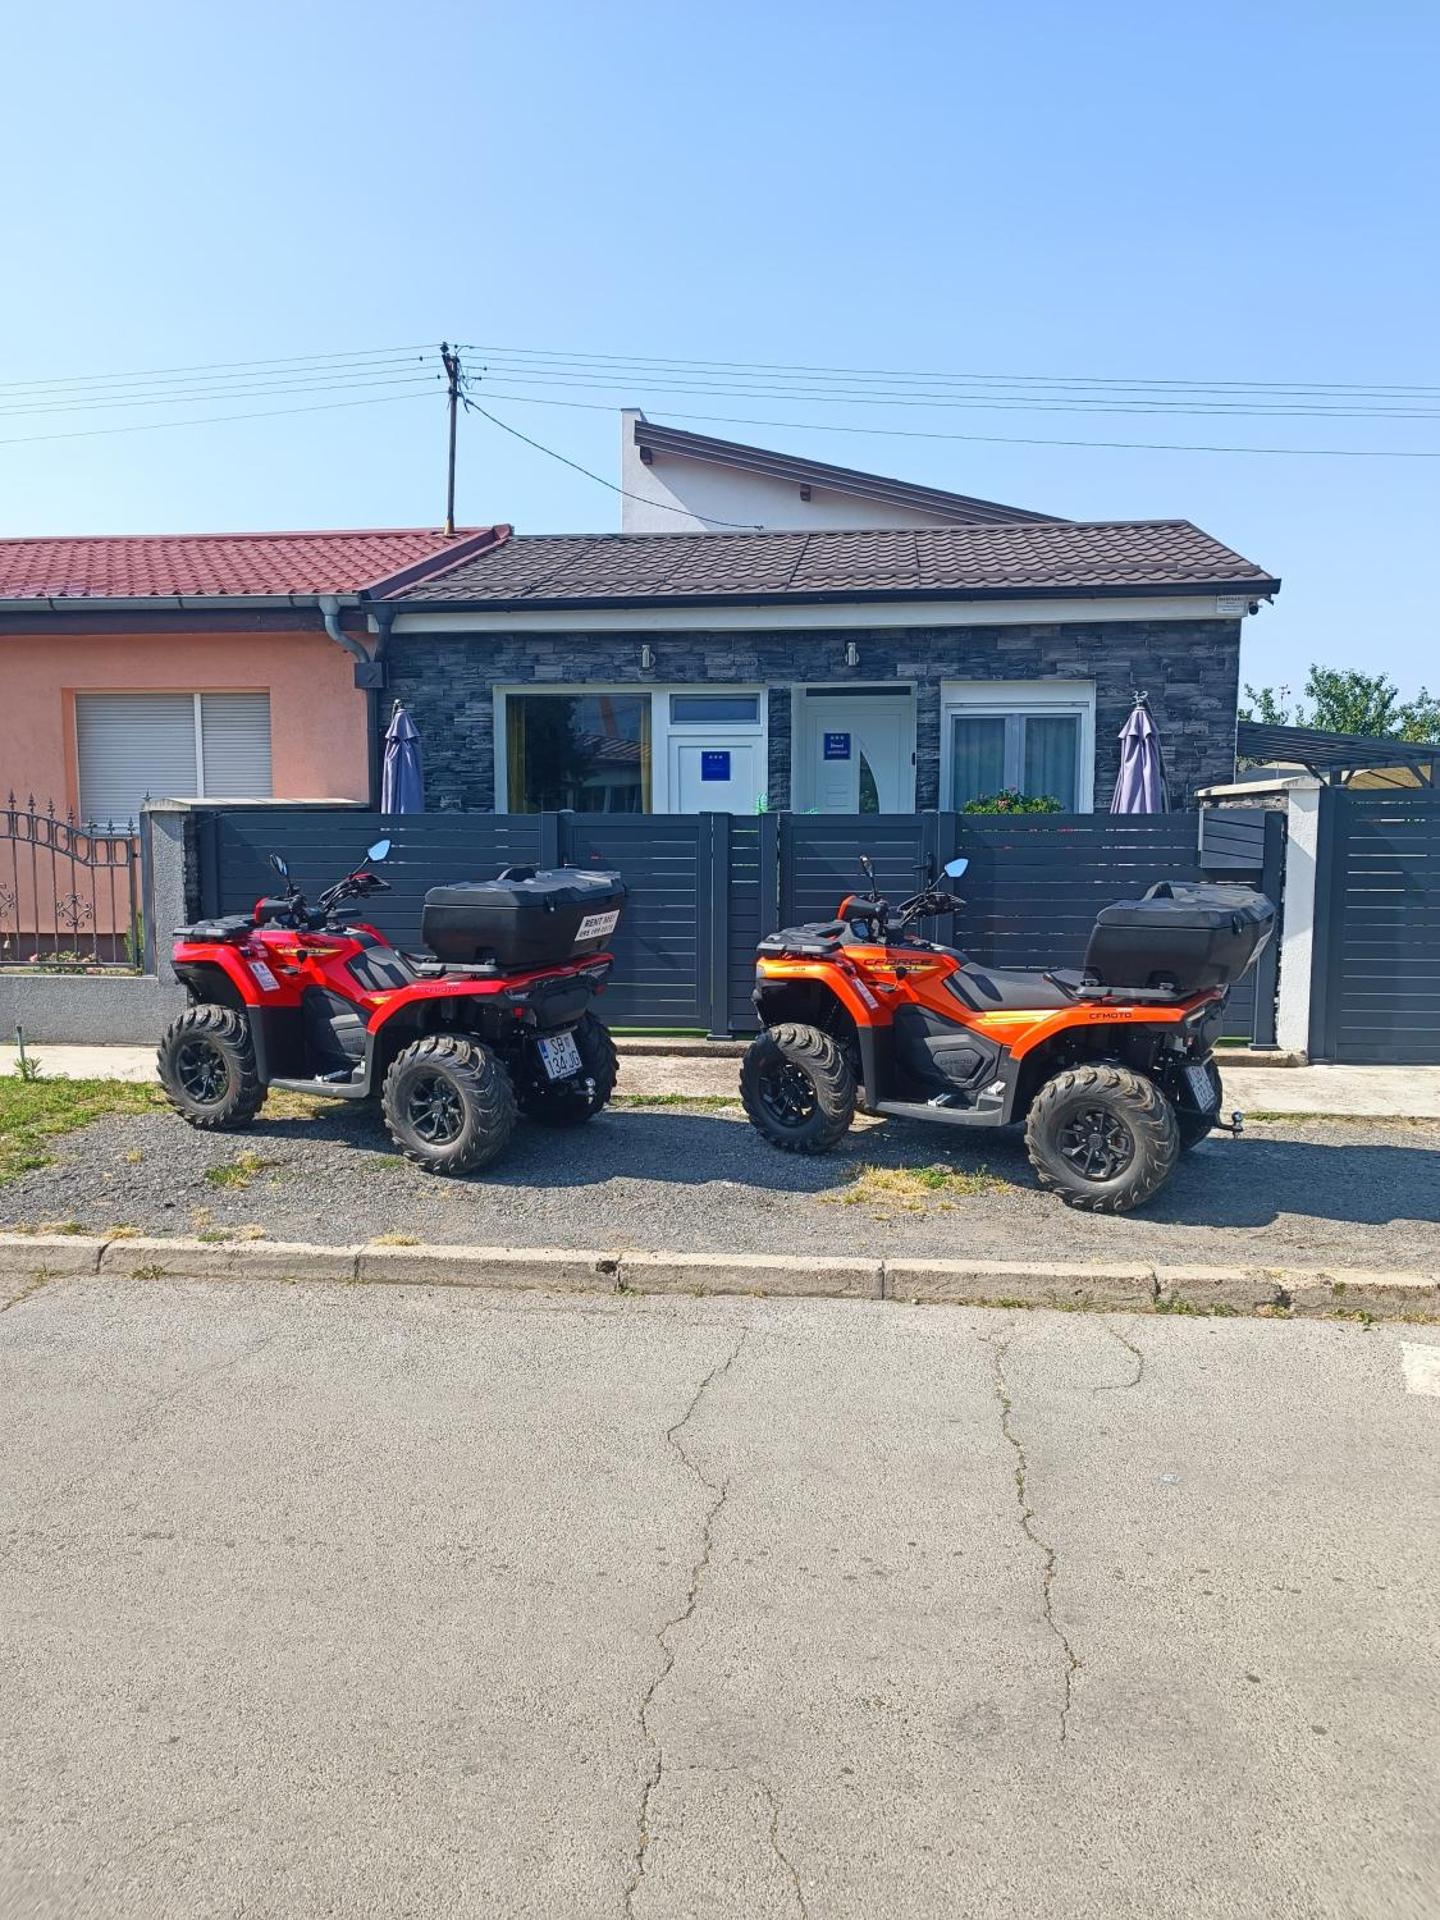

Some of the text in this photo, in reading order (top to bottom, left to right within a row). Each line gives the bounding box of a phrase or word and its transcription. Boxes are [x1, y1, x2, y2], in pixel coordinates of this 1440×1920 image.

[585, 917, 603, 928] RENT
[864, 958, 933, 966] CFORCE
[1089, 1012, 1132, 1020] CFMOTO
[550, 1037, 565, 1055] SB
